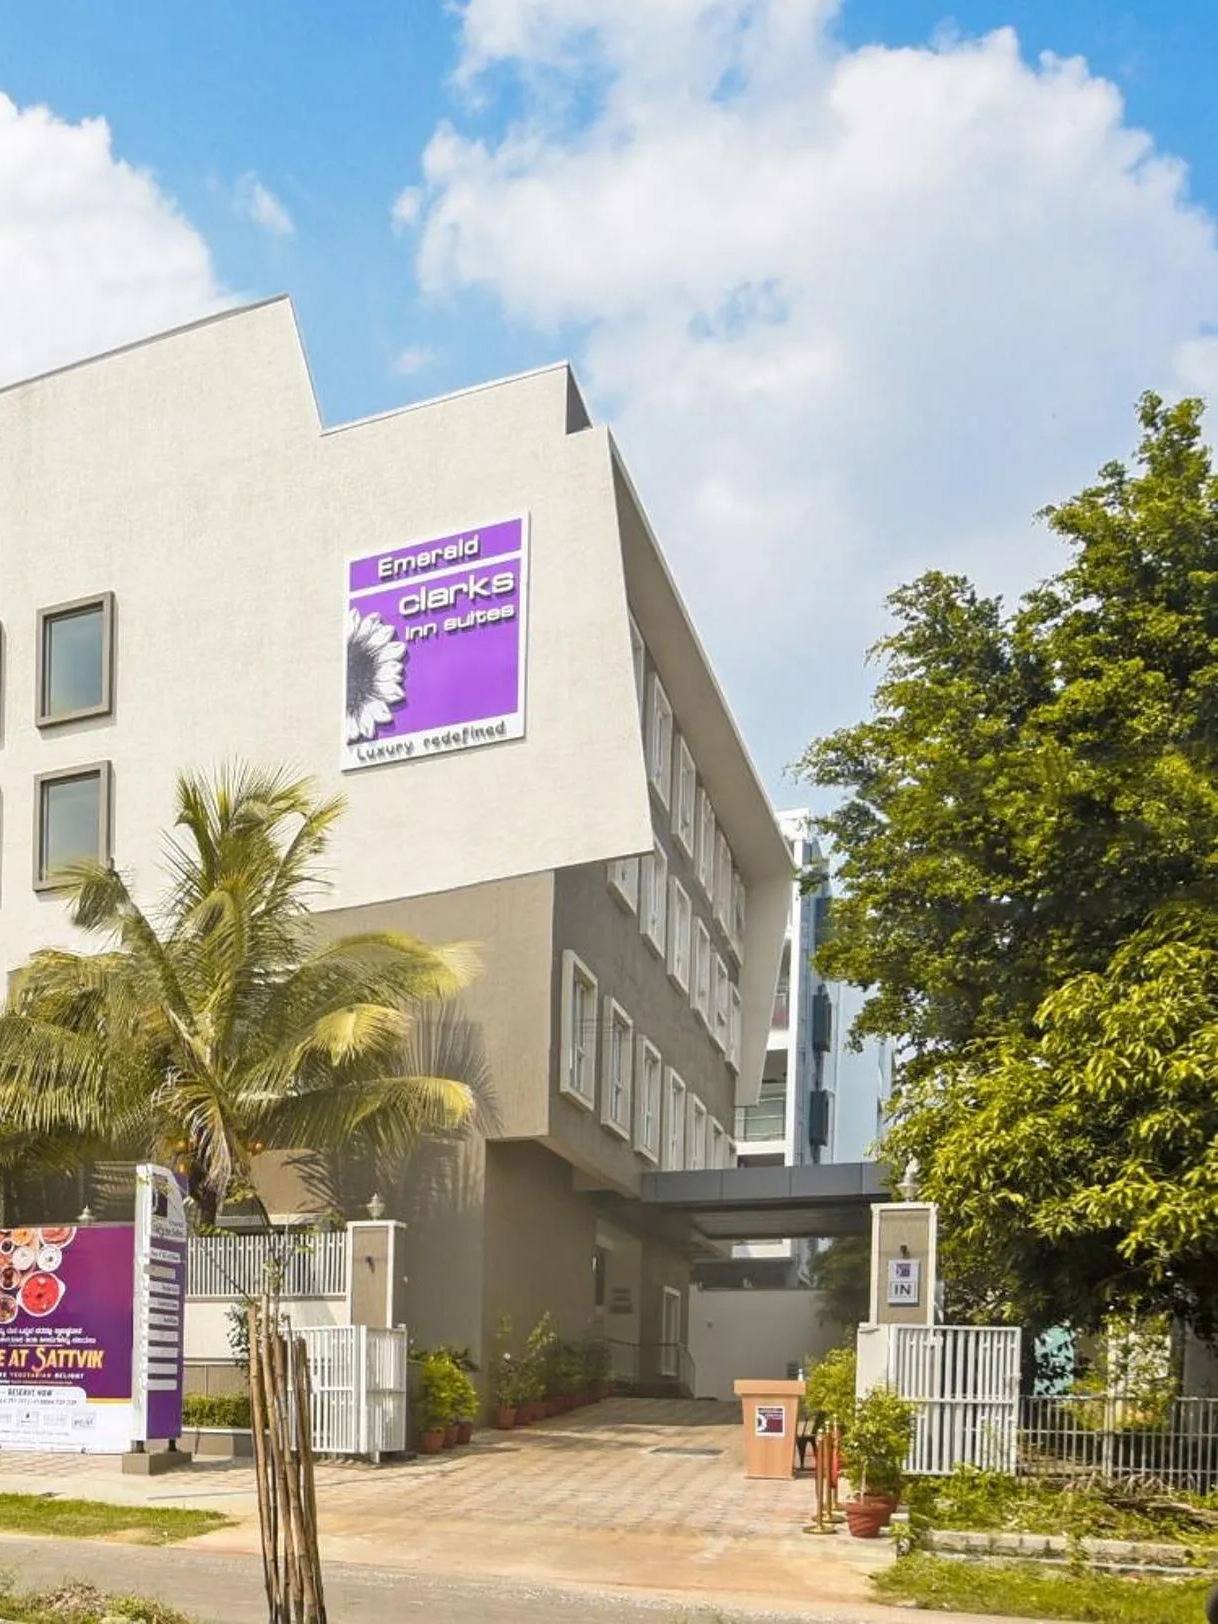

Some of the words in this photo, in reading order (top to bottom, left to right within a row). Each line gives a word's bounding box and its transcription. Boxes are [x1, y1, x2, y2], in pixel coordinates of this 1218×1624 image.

[378, 534, 479, 579] Emerald
[399, 572, 515, 616] clarks
[444, 603, 515, 632] suites
[356, 740, 414, 763] Luxury
[423, 721, 506, 751] redefined
[894, 1284, 912, 1296] IN
[8, 1349, 30, 1368] AT
[31, 1346, 105, 1373] SATTVIK
